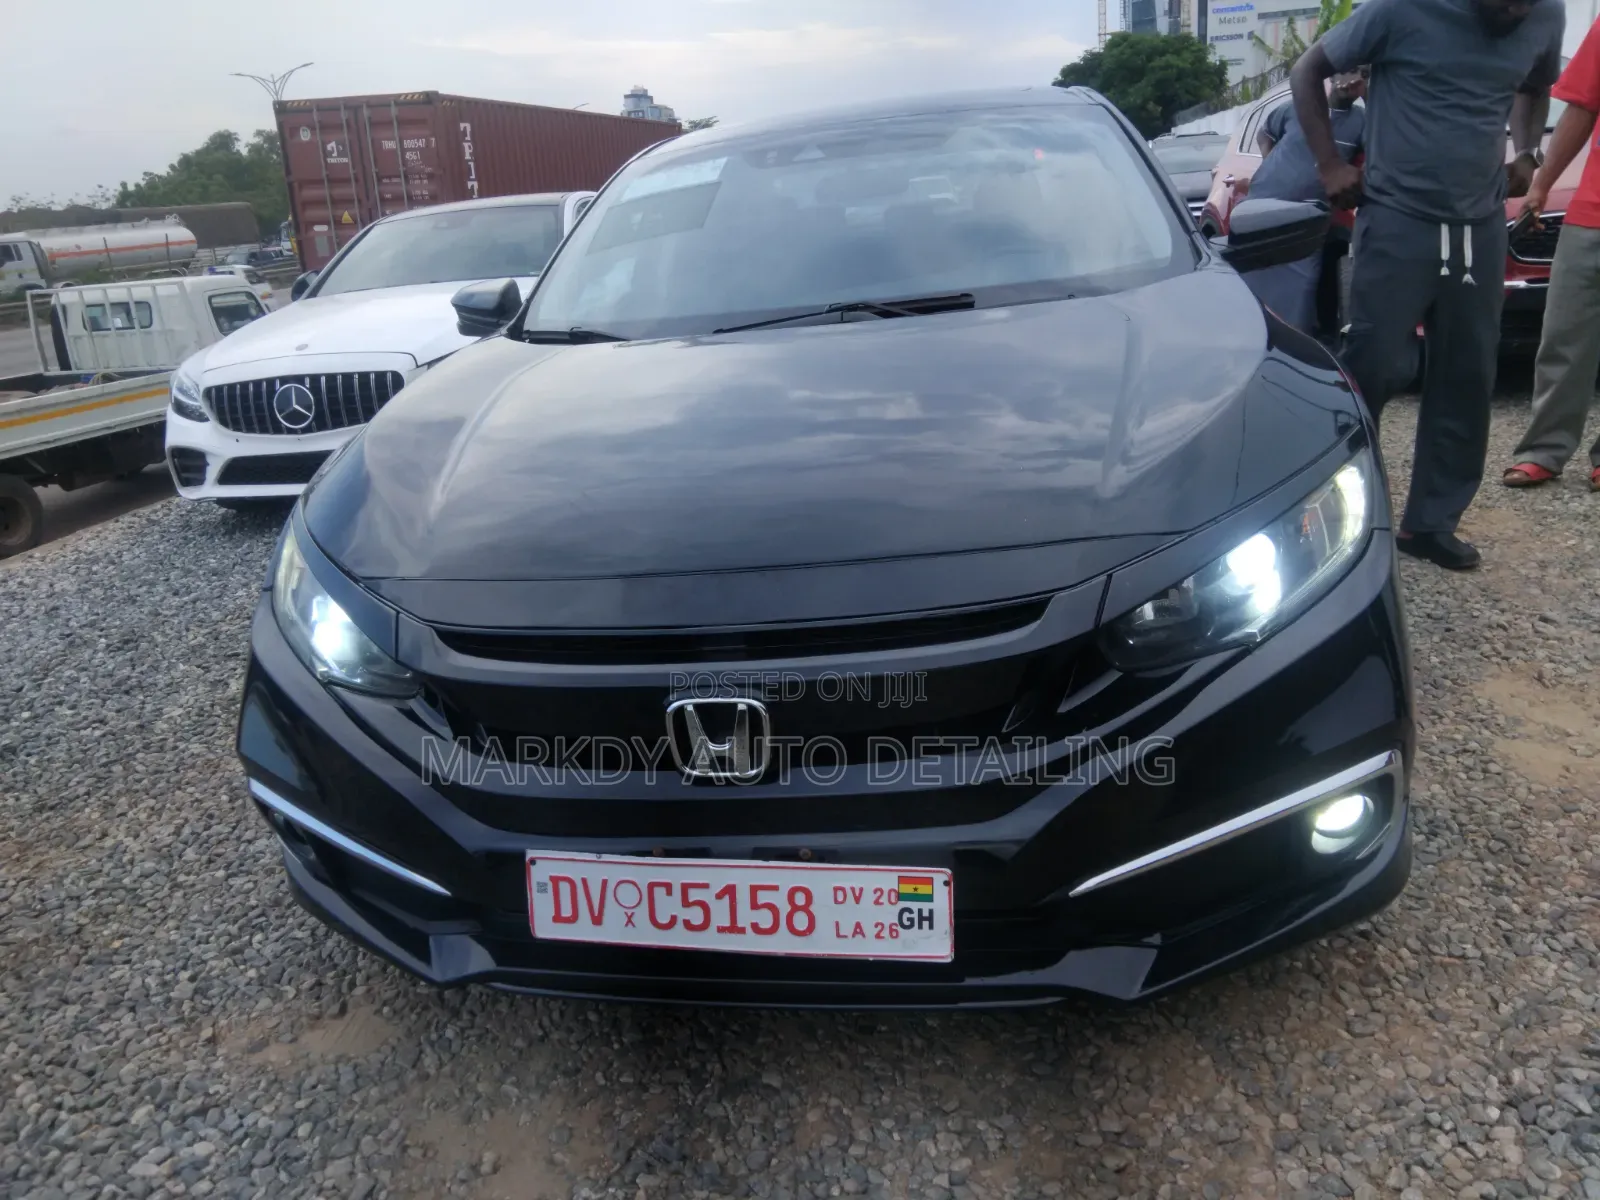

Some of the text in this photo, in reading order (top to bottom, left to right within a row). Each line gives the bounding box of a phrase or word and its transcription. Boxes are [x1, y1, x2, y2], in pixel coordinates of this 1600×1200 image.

[1219, 16, 1247, 25] Metso
[1210, 33, 1244, 42] ERICSSON
[549, 874, 816, 937] DV C5158
[833, 886, 898, 906] DV 20
[898, 907, 935, 931] GH
[834, 921, 899, 940] LA 26
